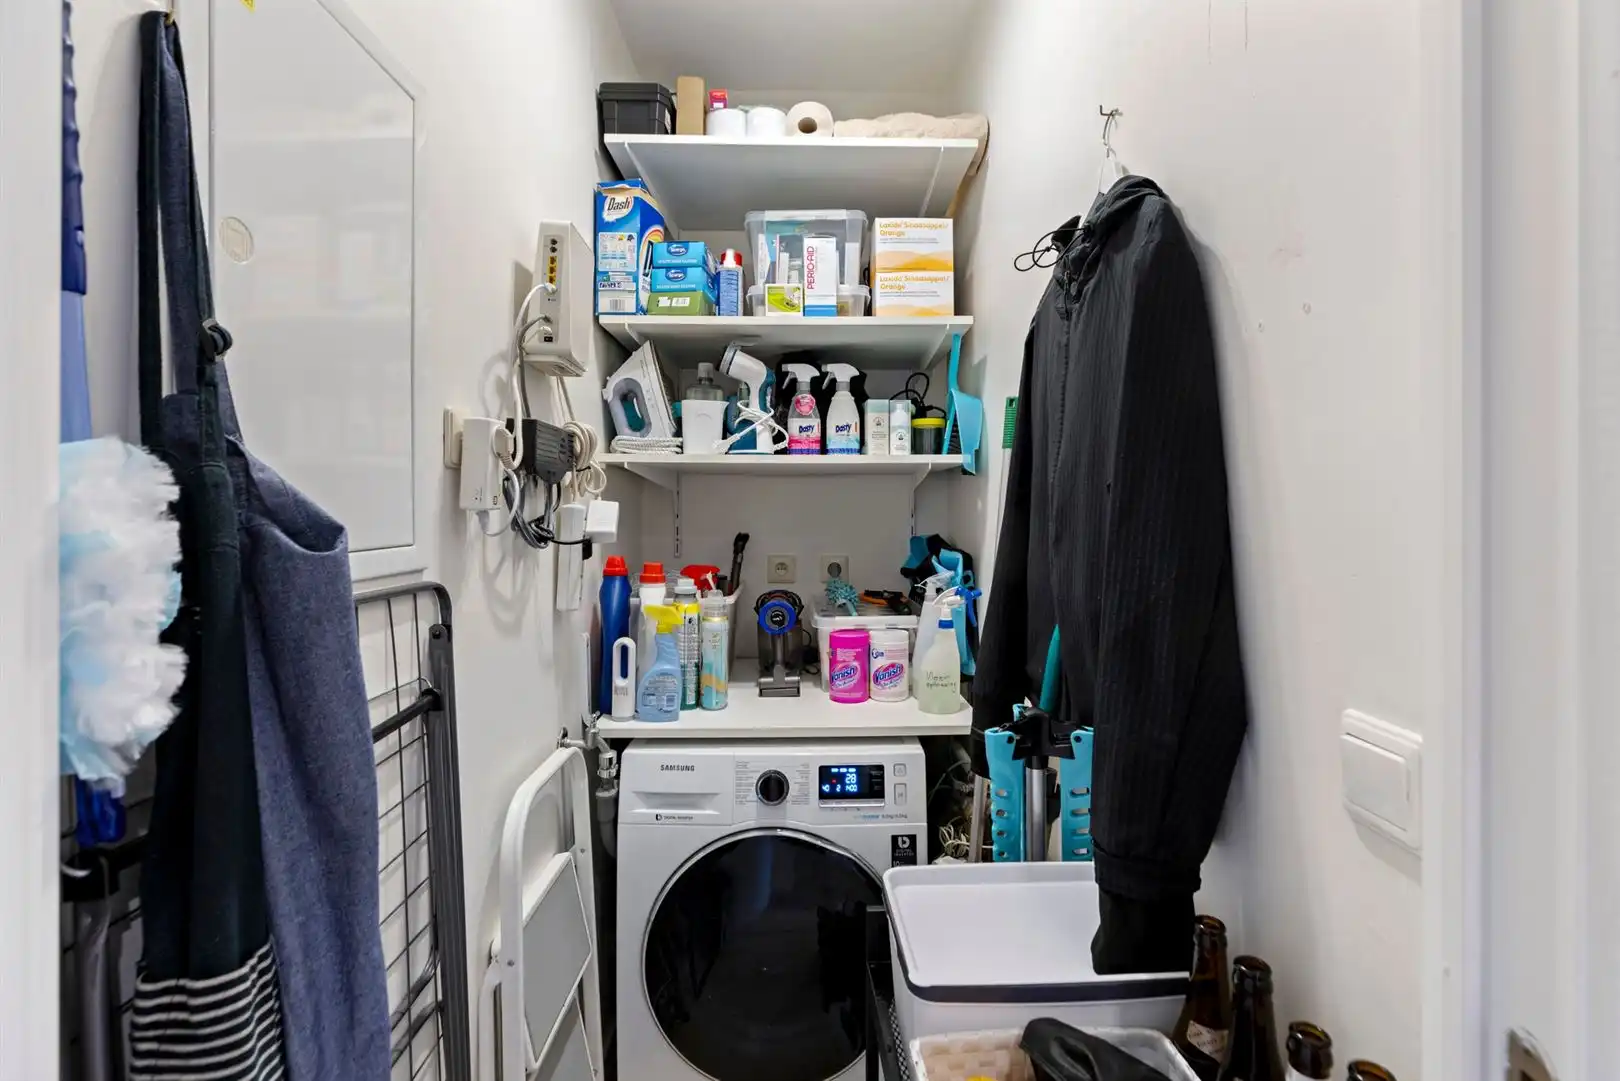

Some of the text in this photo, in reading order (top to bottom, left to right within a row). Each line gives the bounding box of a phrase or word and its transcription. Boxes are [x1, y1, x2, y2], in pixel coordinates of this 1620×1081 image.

[607, 197, 630, 211] Dash
[799, 424, 815, 434] Dasty
[835, 423, 852, 434] Dasty
[875, 663, 901, 684] Vanish
[660, 764, 695, 772] SAMSUNG
[845, 773, 857, 784] 28
